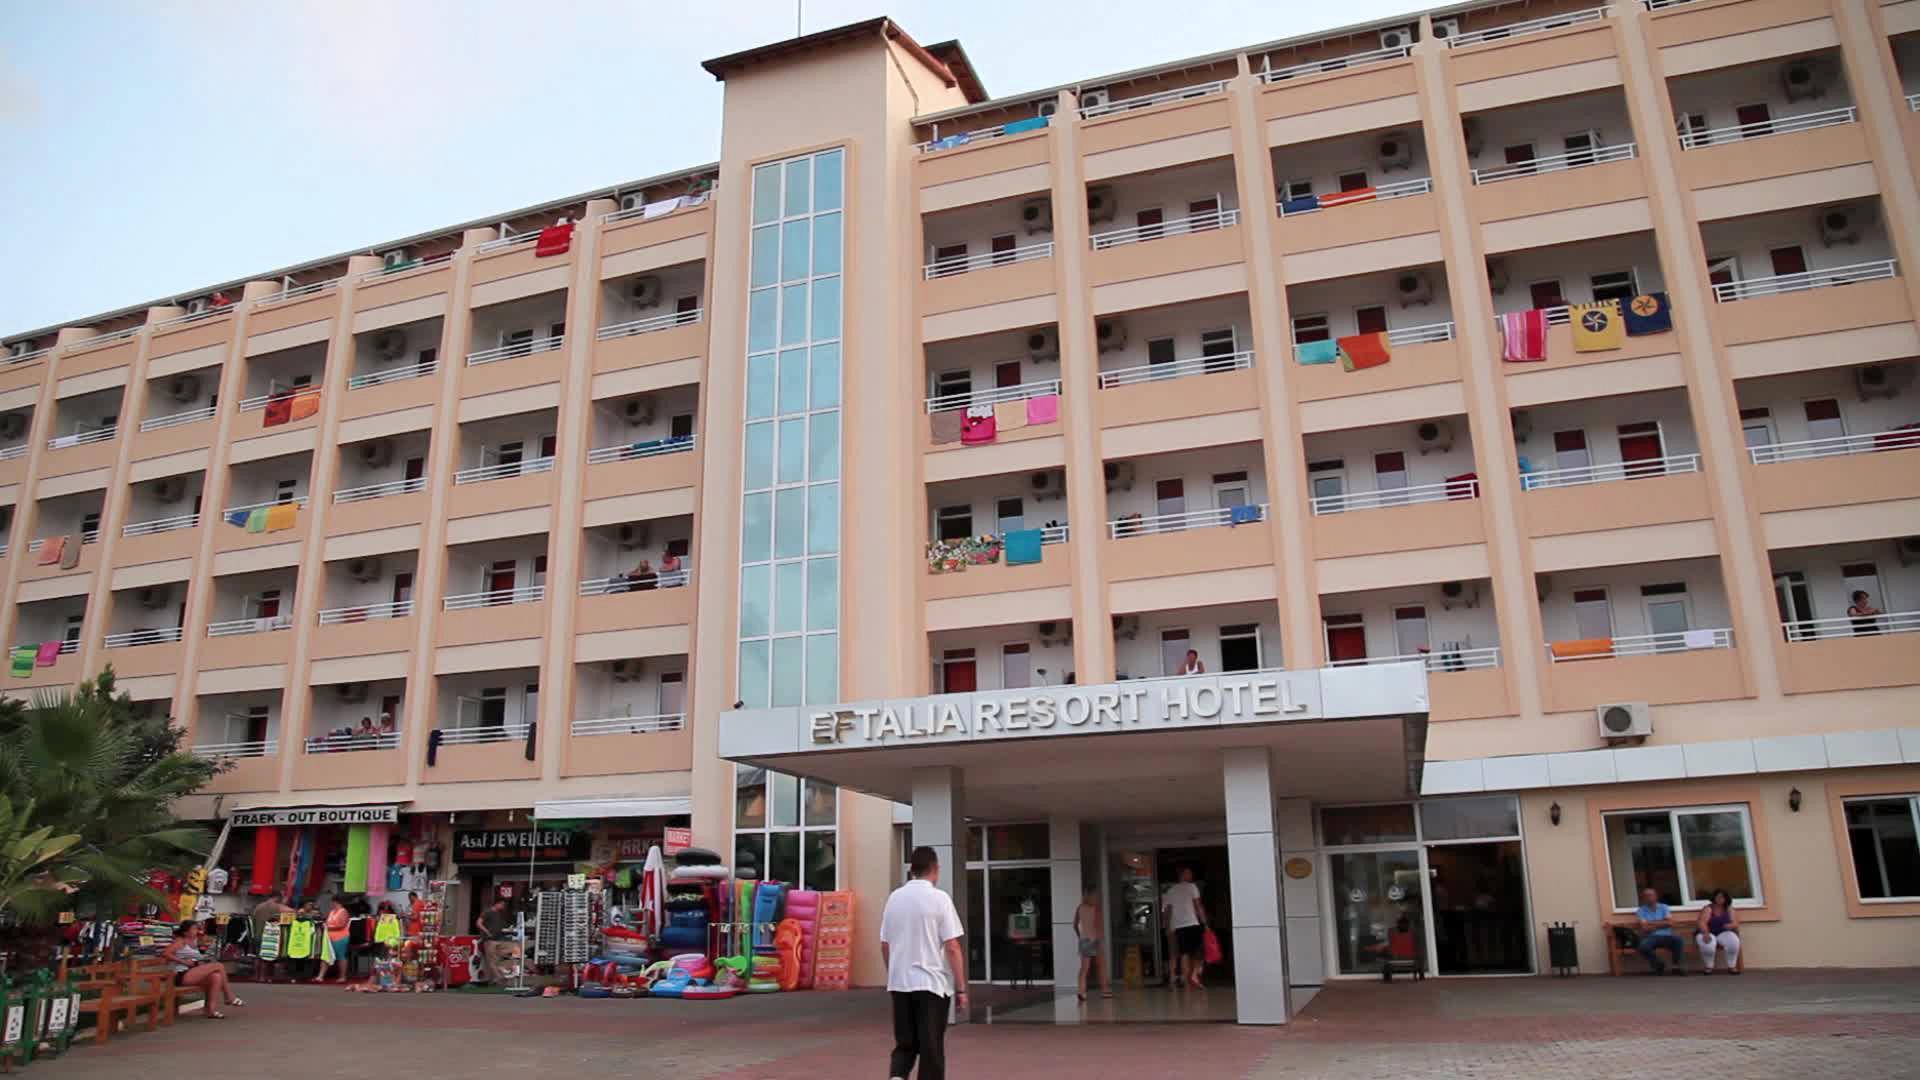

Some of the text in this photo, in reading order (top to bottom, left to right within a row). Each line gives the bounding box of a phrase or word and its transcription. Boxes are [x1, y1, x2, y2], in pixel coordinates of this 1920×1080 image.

[810, 679, 1307, 744] EFTALIA RESORT HOTEL
[233, 813, 276, 825] FRAEK
[288, 811, 317, 823] OUT
[319, 809, 391, 823] BOUTIQUE
[489, 831, 571, 847] JEWELLERY
